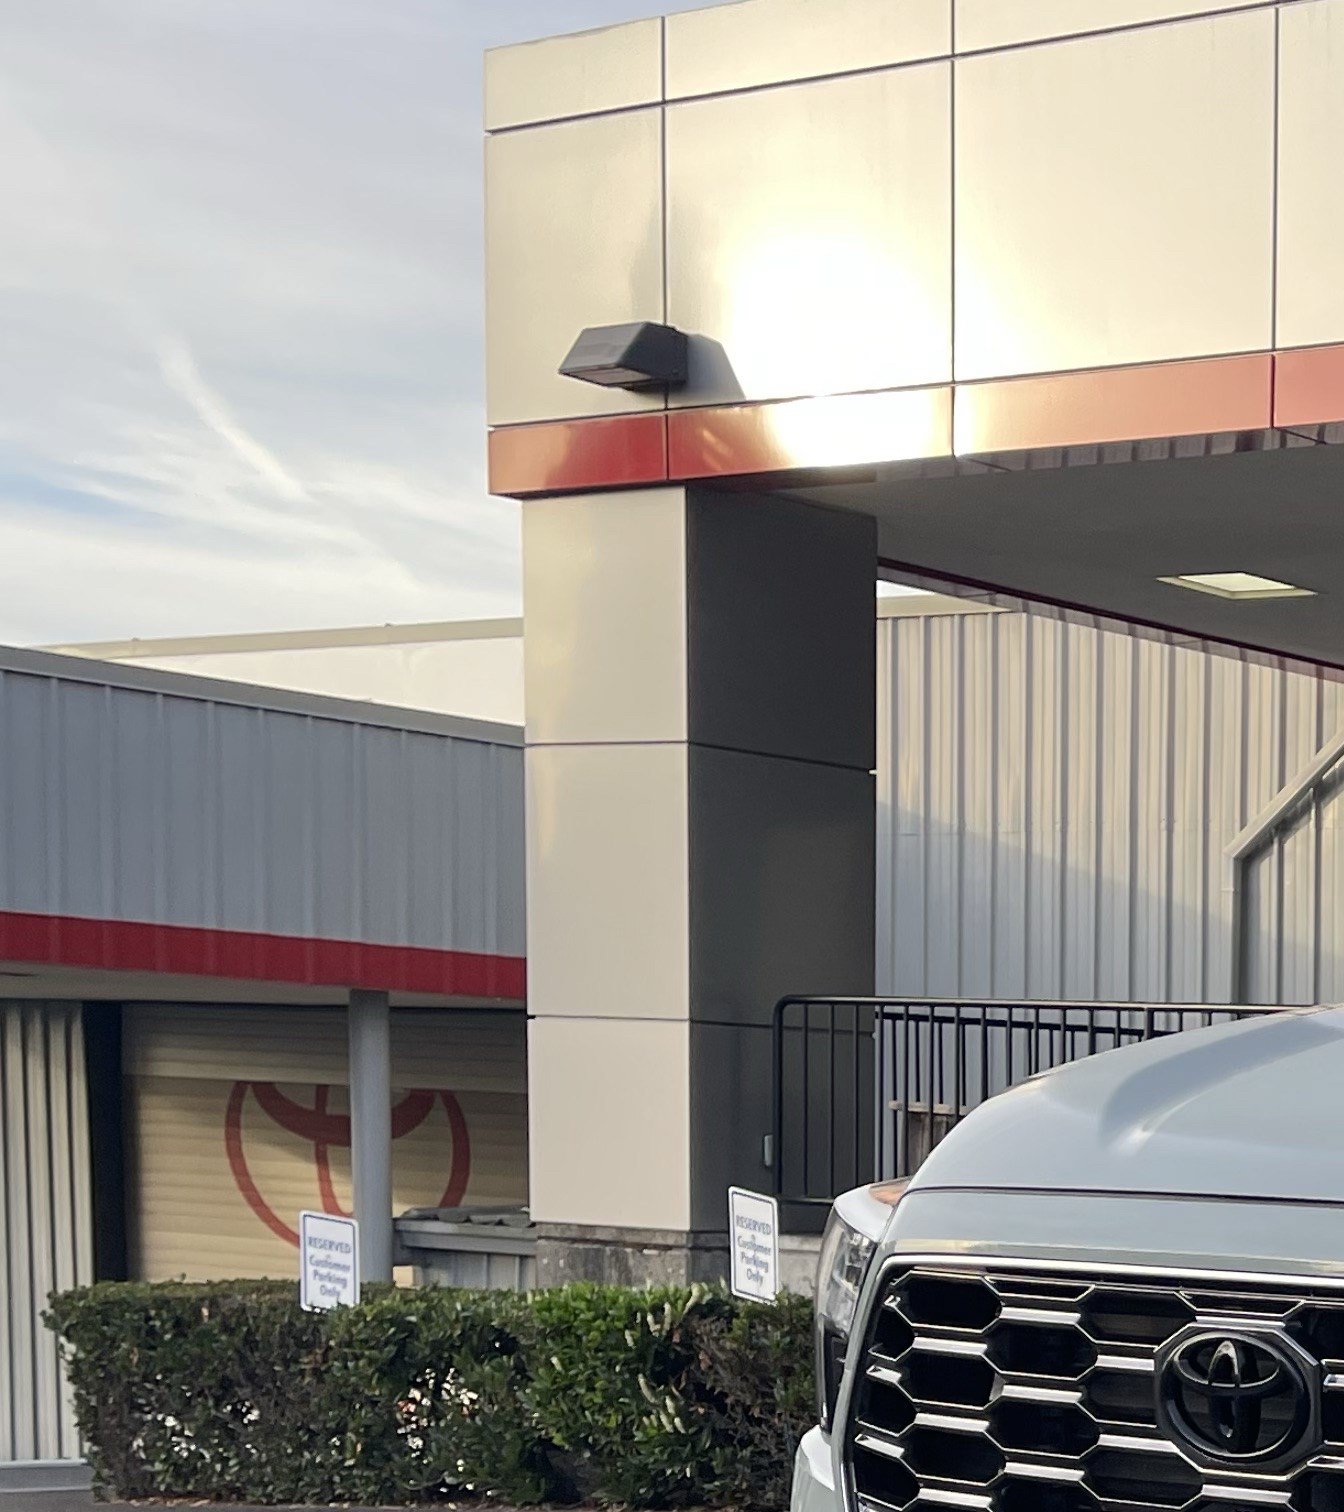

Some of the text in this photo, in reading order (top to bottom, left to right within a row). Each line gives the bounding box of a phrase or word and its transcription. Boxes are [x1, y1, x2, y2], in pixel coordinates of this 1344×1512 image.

[736, 1215, 772, 1235] RESERVED
[308, 1236, 351, 1254] RESERVED
[737, 1235, 771, 1256] Customer
[309, 1254, 351, 1271] Customer
[741, 1251, 769, 1273] Parking
[313, 1269, 348, 1289] Parking
[746, 1268, 764, 1287] Only
[320, 1284, 340, 1298] Only
